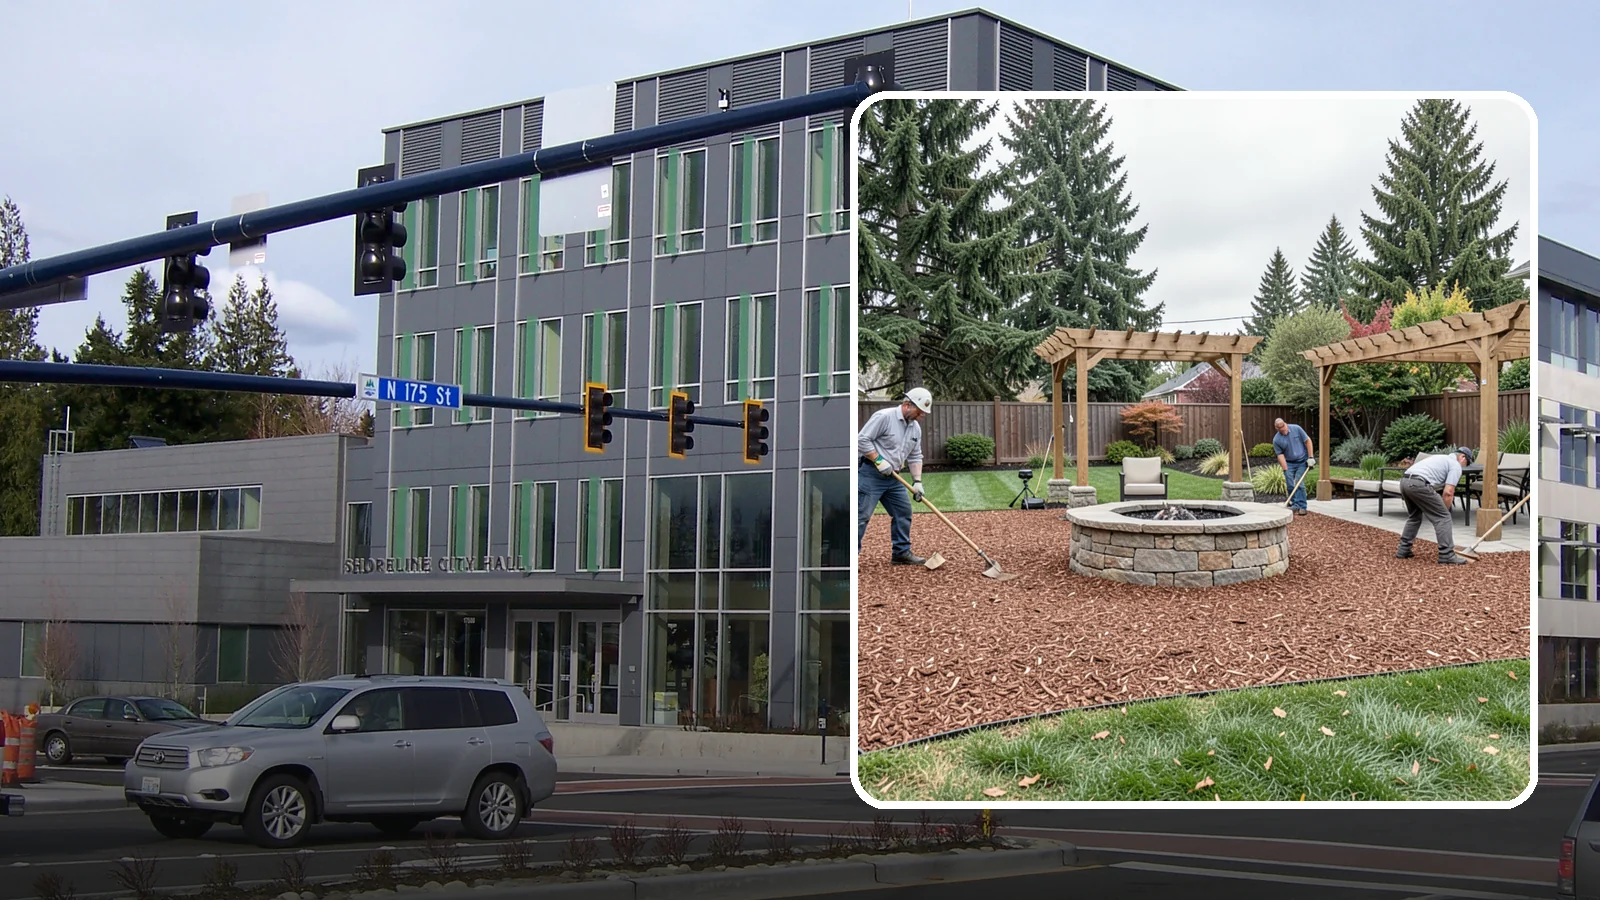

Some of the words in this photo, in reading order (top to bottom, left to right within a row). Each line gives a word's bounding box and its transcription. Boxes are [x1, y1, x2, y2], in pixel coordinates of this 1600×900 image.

[387, 380, 396, 400] N
[405, 383, 428, 403] 175
[436, 386, 452, 406] St
[344, 557, 432, 574] SHORELINE
[438, 556, 475, 572] CITY
[483, 555, 525, 571] HALL
